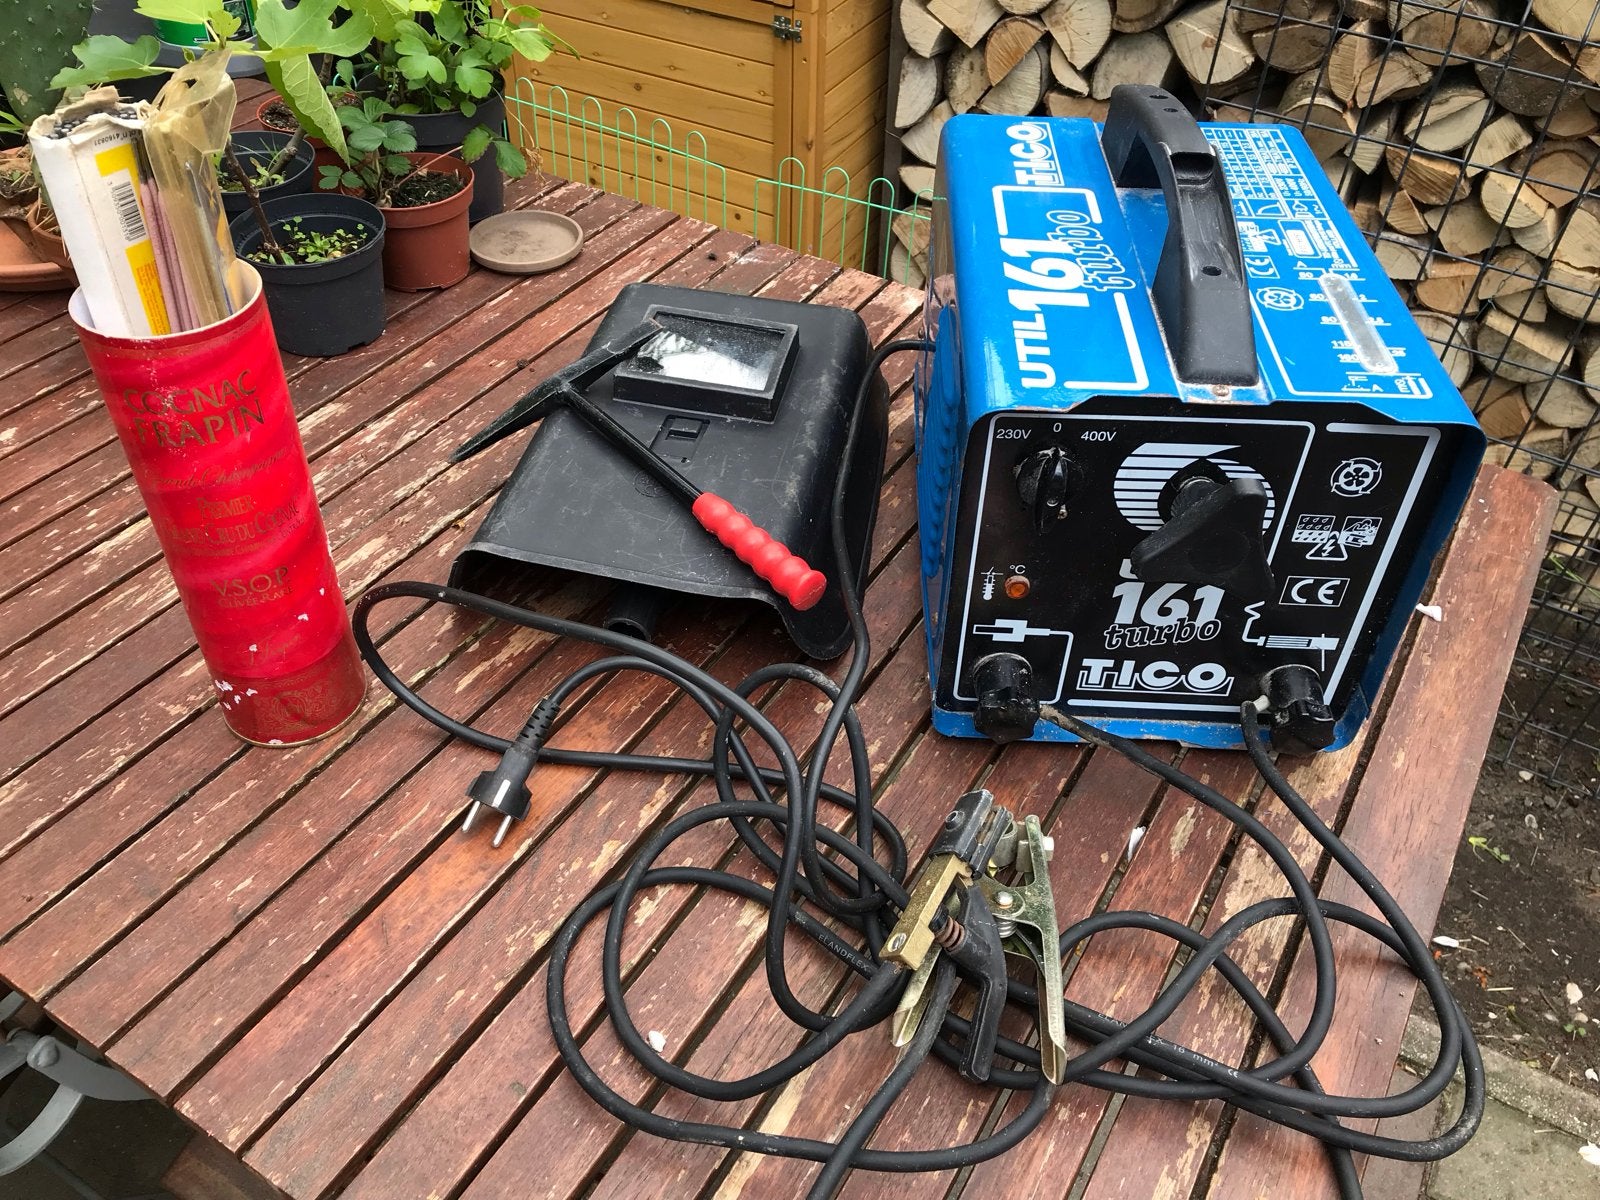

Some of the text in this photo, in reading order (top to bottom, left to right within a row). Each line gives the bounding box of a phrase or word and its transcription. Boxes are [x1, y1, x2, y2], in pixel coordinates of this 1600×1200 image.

[1006, 122, 1064, 186] TICO
[1000, 210, 1136, 389] UTIL 161 turbo
[123, 370, 258, 415] COGNAC
[133, 396, 264, 447] FRAPIN
[996, 428, 1032, 439] 230V
[1053, 422, 1062, 433] 0
[1081, 431, 1117, 441] 400V
[1112, 582, 1225, 627] 161
[1291, 579, 1341, 604] CE
[1104, 616, 1222, 650] turbo
[1078, 658, 1231, 693] TICO
[818, 934, 871, 973] ELANDFLEX
